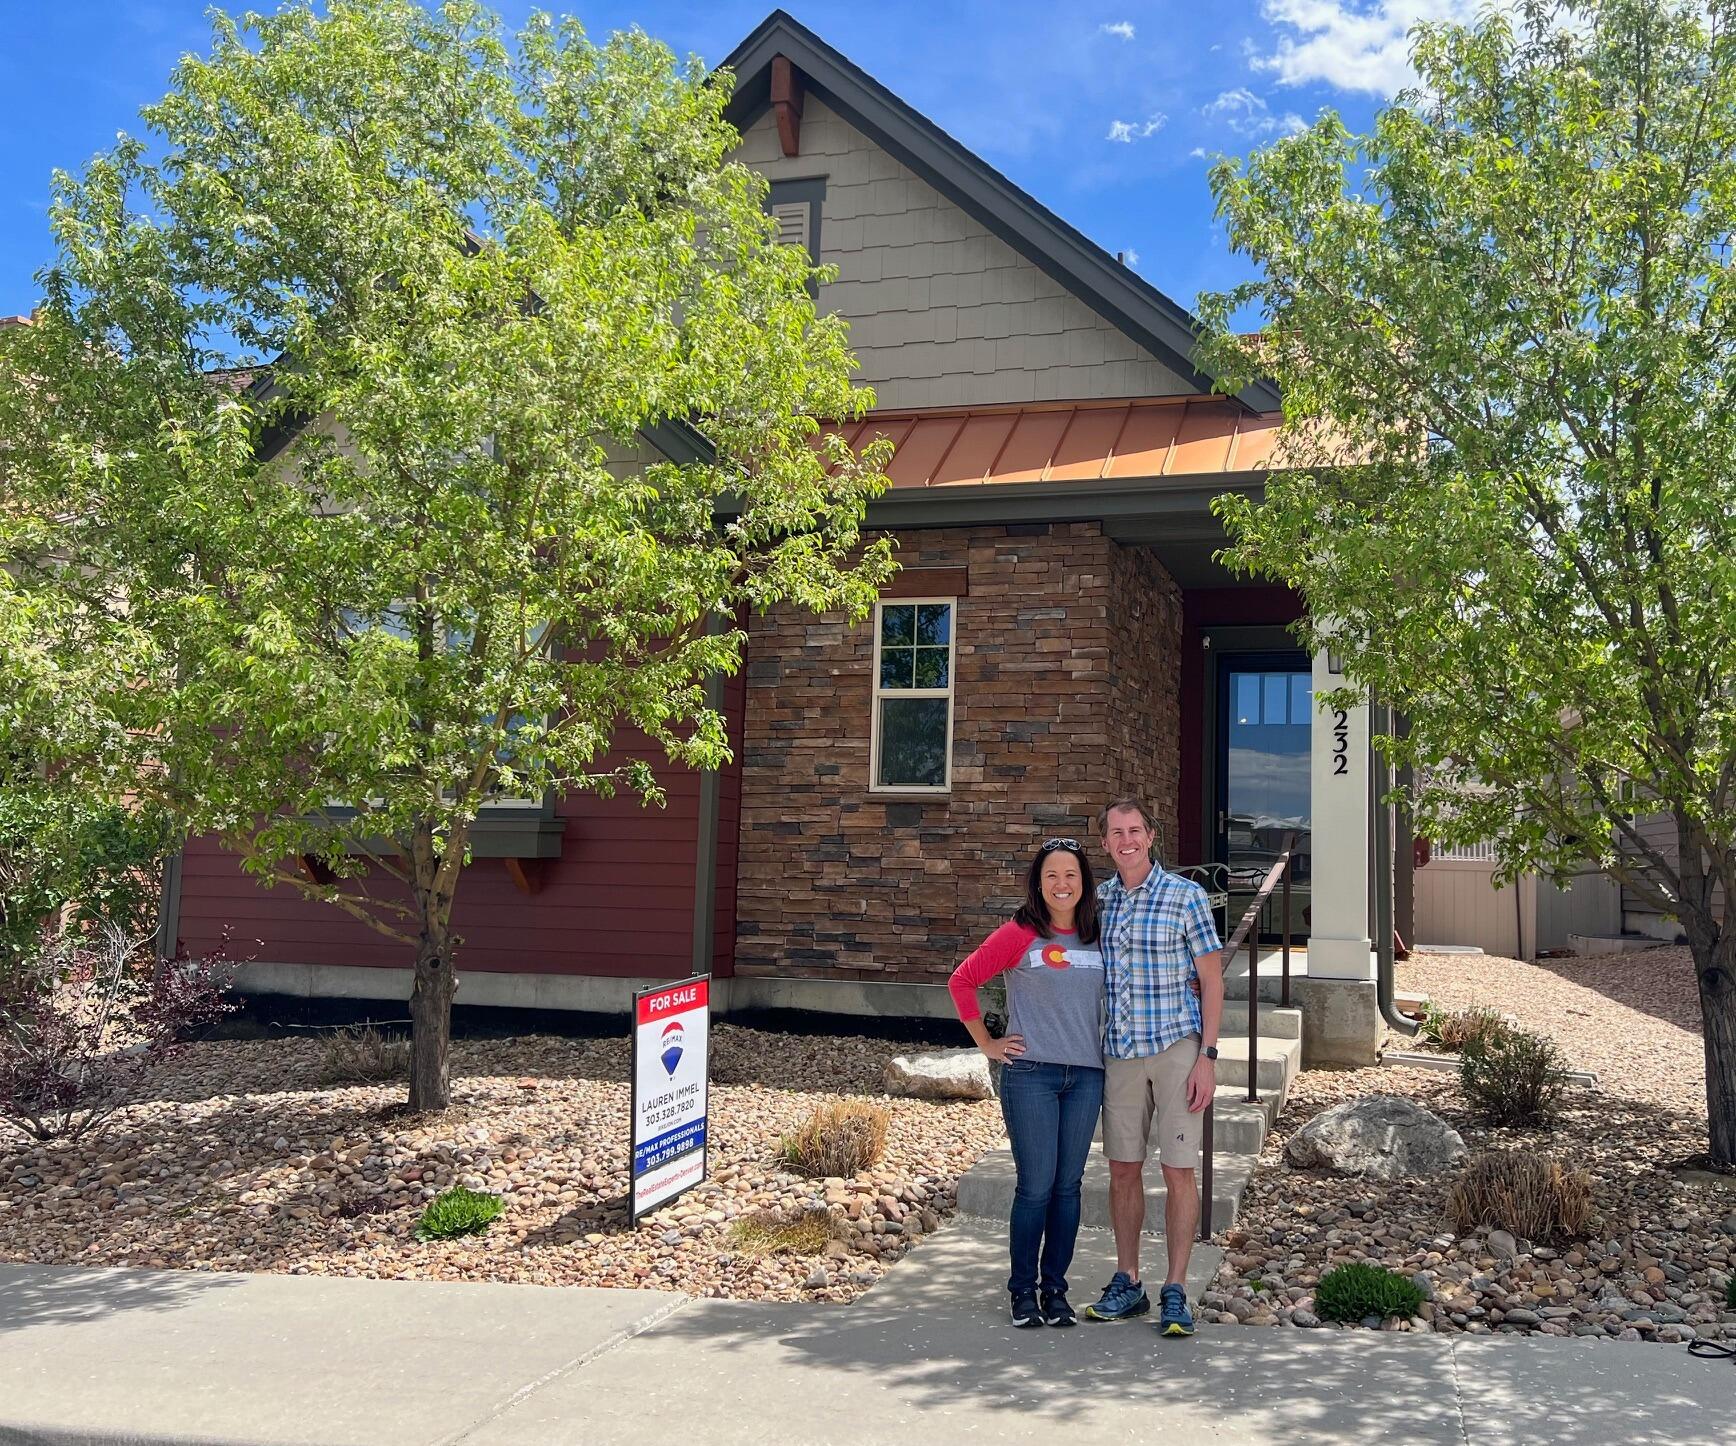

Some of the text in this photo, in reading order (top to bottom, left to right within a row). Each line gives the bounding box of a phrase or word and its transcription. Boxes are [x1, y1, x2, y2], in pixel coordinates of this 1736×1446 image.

[1332, 687, 1349, 776] 232
[649, 987, 697, 1013] FOR SALE
[642, 1082, 700, 1114] LAUREN IMMEL
[645, 1098, 695, 1127] 303.328.7820
[635, 1141, 659, 1160] RE/MAX
[659, 1122, 705, 1149] PROFESSIONALS
